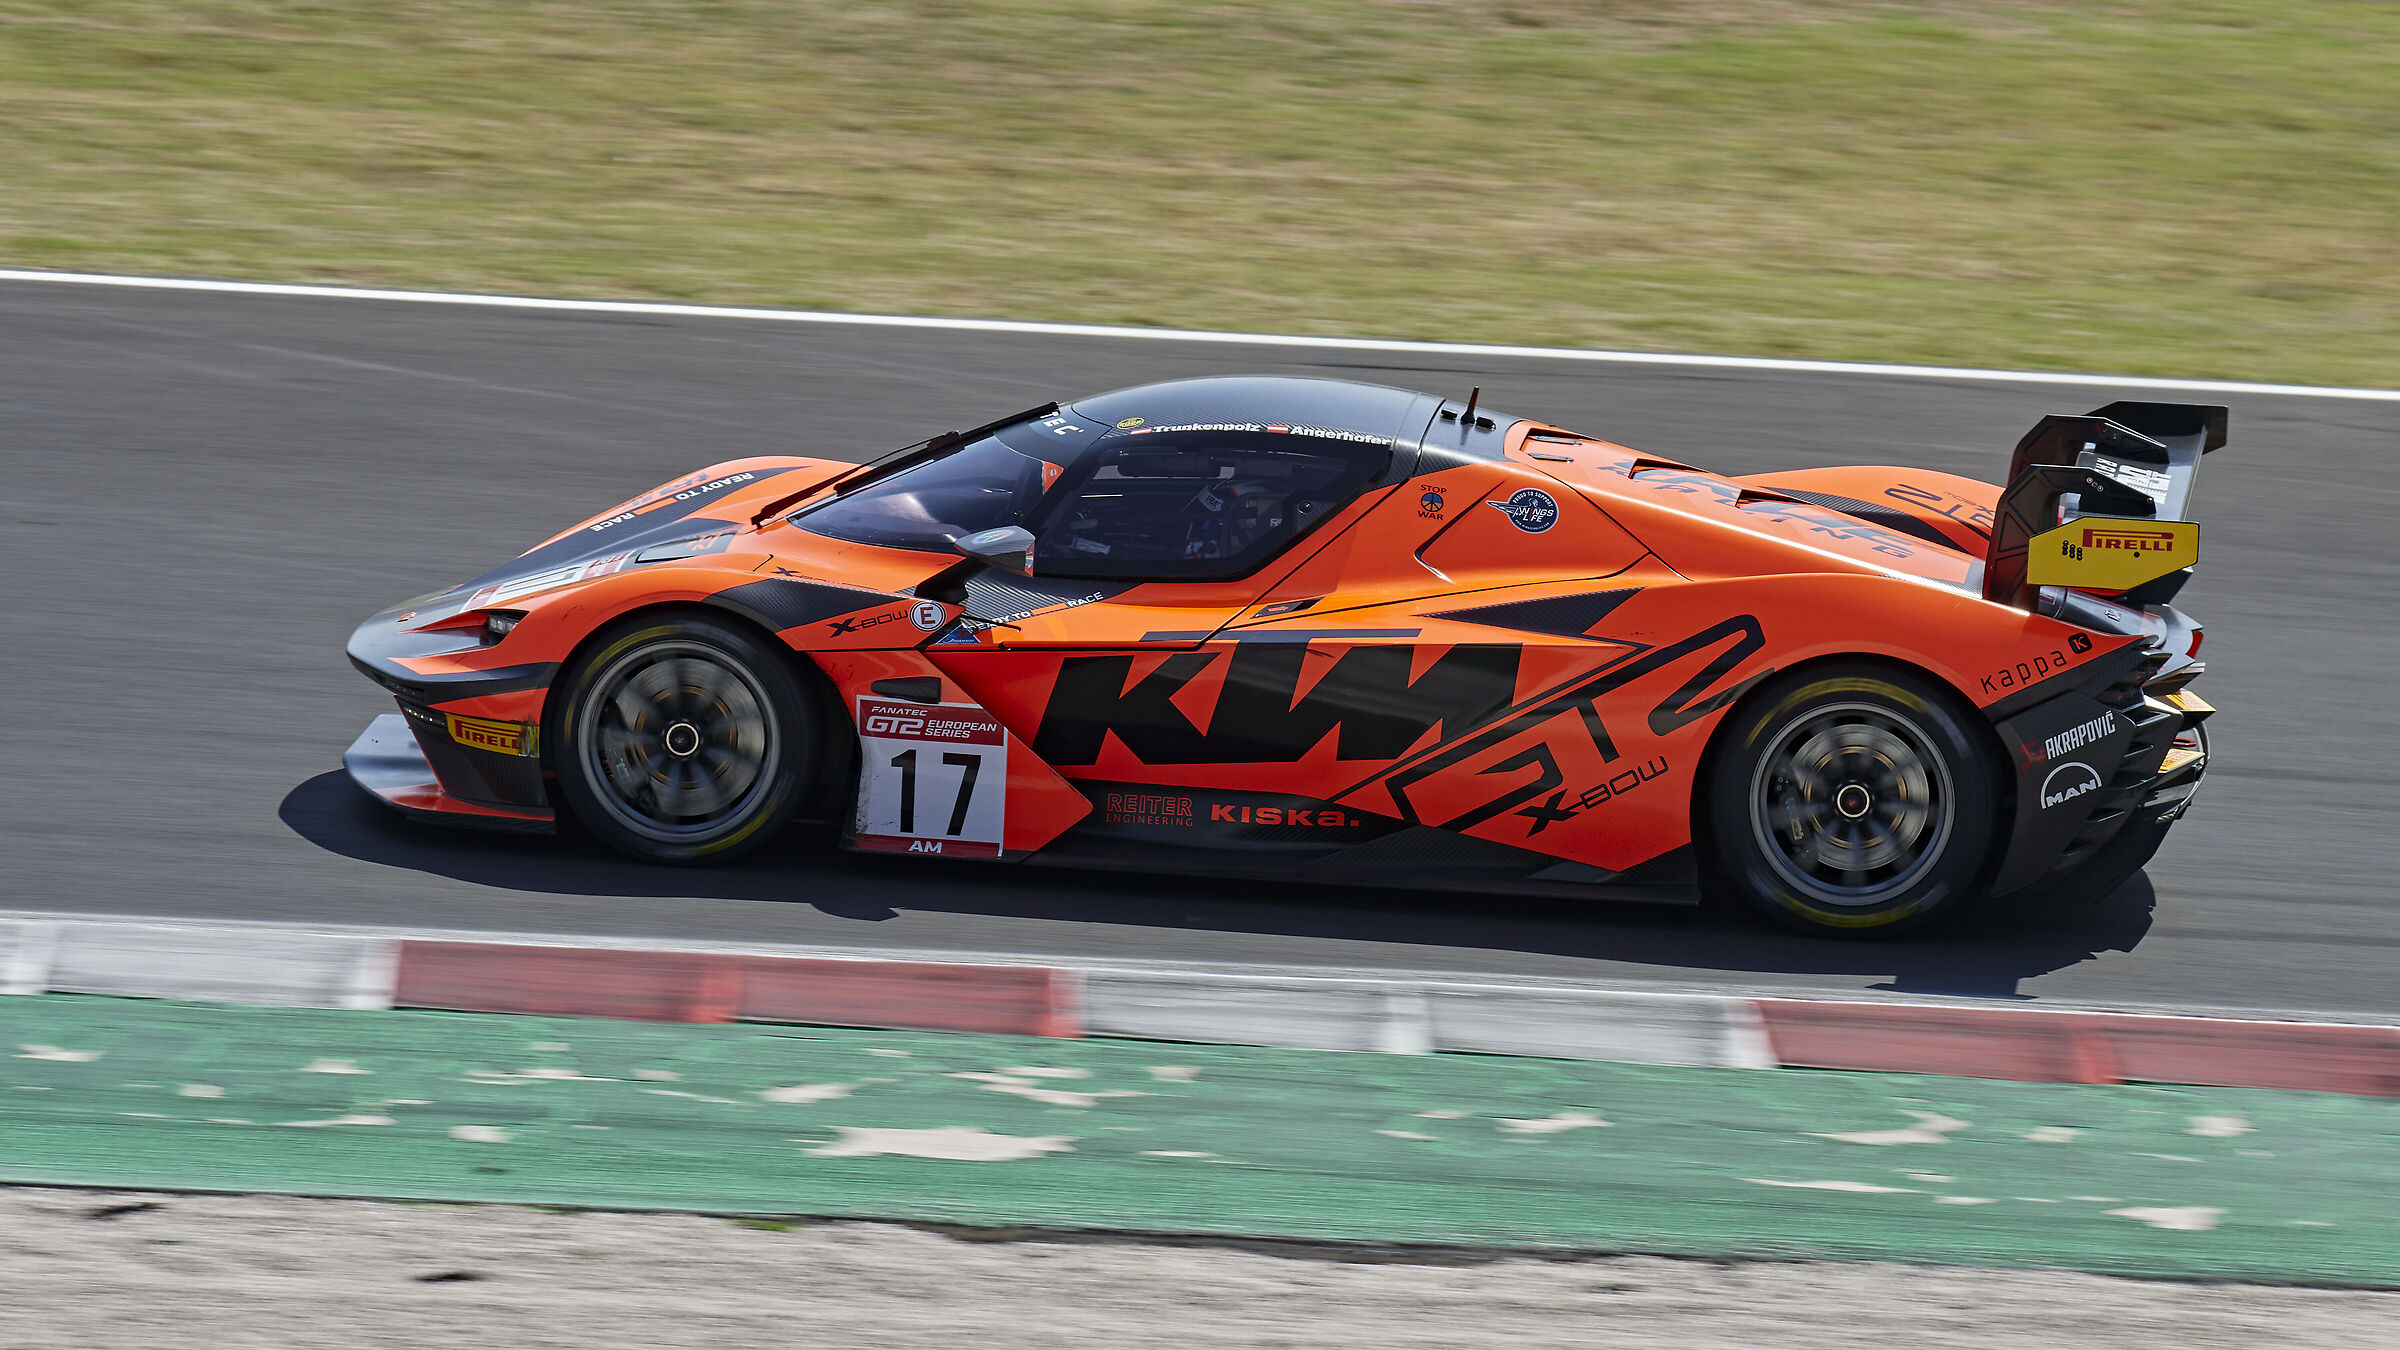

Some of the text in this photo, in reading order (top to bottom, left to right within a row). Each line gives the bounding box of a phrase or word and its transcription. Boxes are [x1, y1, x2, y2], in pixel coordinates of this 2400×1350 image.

[1153, 423, 1262, 433] Trunkenpolz
[701, 472, 755, 493] READY
[1420, 484, 1447, 494] STOP
[675, 489, 701, 501] TO
[589, 512, 637, 532] RACE
[1418, 510, 1444, 521] WAR
[2082, 528, 2174, 552] PIRELLI
[920, 606, 936, 625] E
[1012, 611, 1031, 620] TO
[1067, 592, 1104, 608] RACE
[826, 609, 908, 639] X-BOW
[1033, 628, 1524, 766] KTM
[871, 706, 928, 717] FANATEC
[454, 719, 523, 750] PIRELL
[866, 715, 998, 736] GT2 EUROPEAN
[925, 728, 971, 739] SERIES
[890, 749, 982, 837] 17
[1513, 755, 1670, 838] X-BOW
[2045, 779, 2097, 808] MAN
[1107, 793, 1193, 817] REITER
[1105, 813, 1193, 827] ENGINEERING
[908, 840, 943, 854] AM
